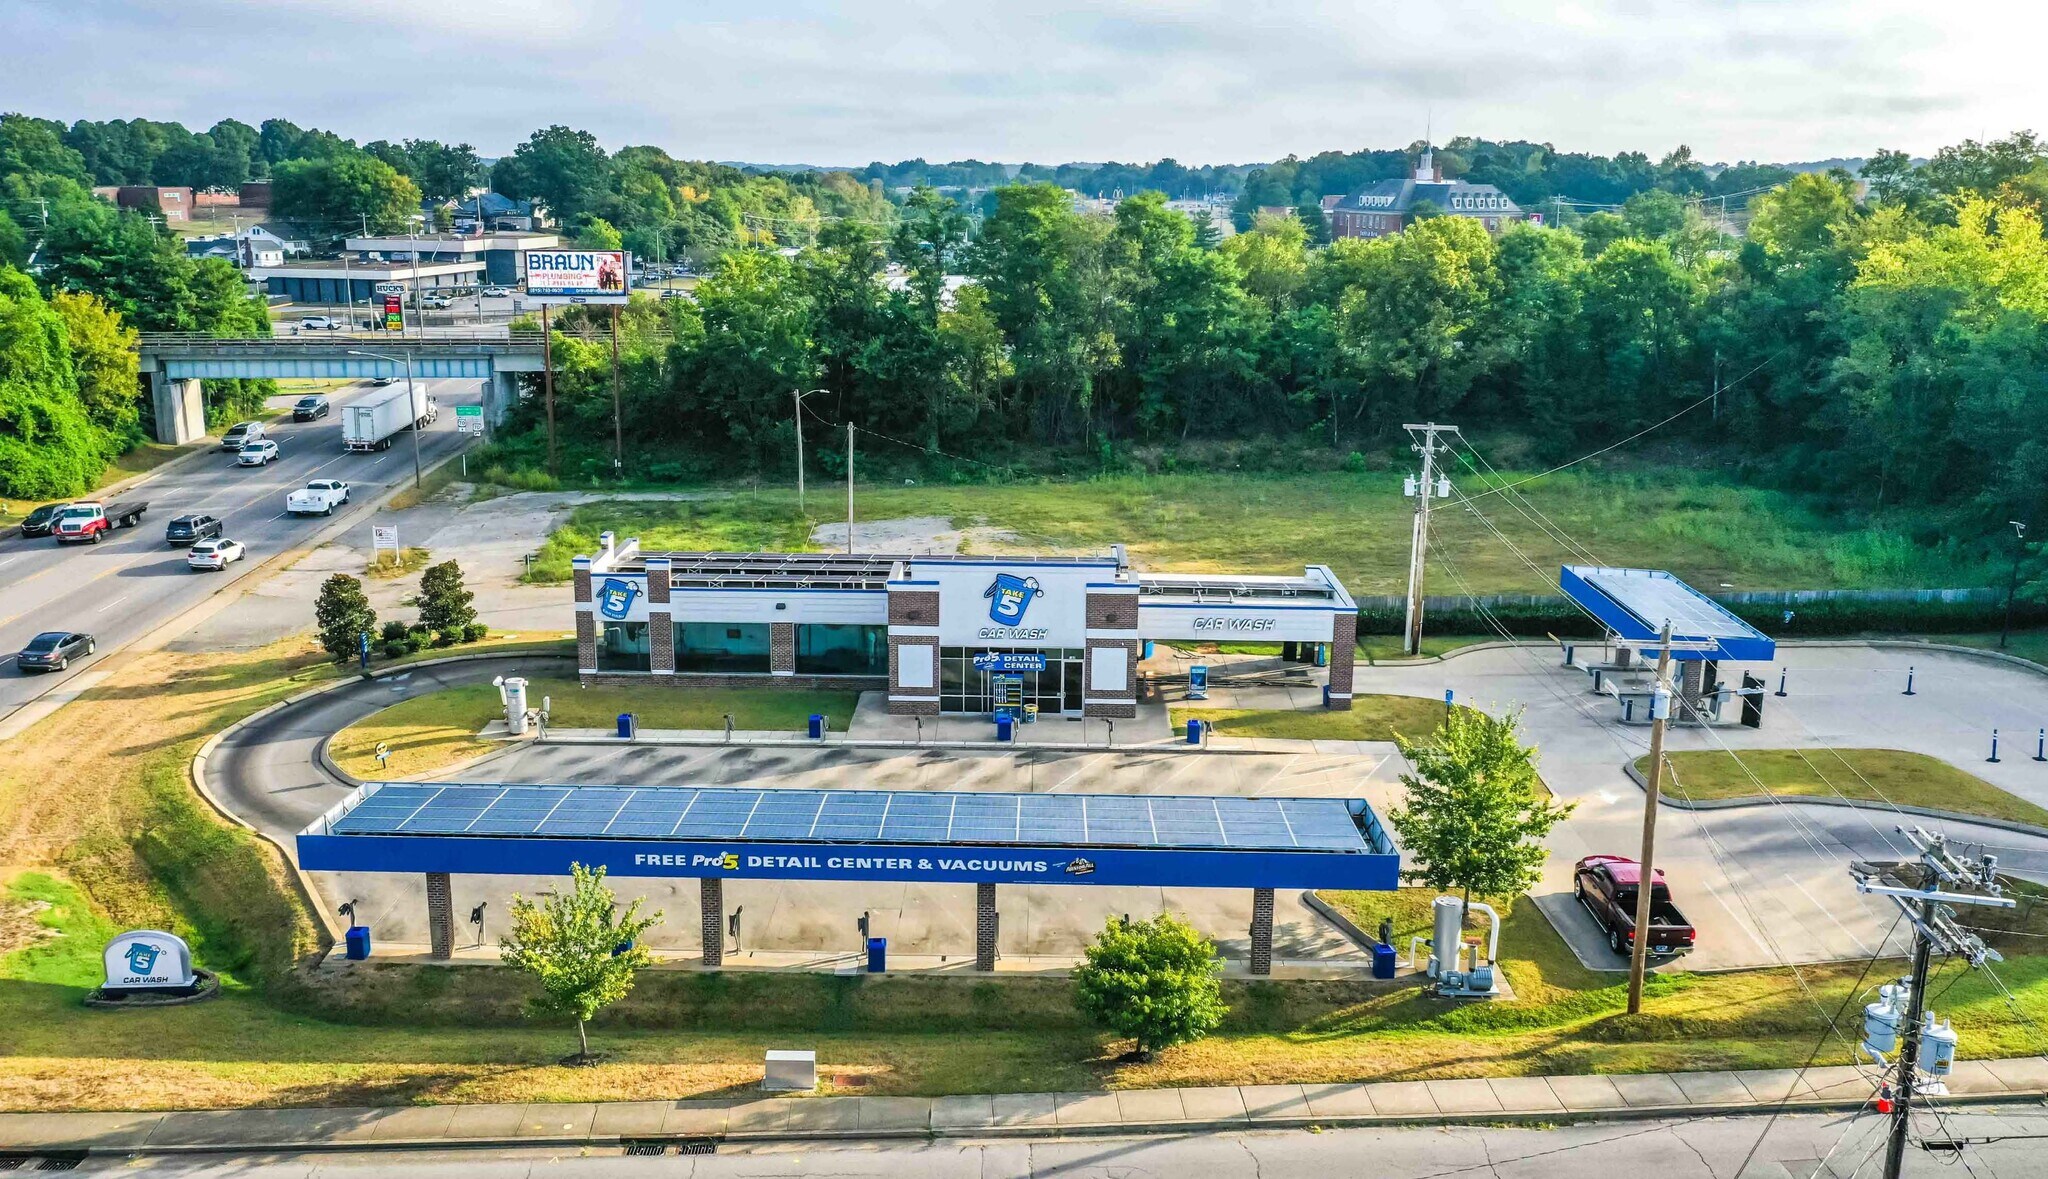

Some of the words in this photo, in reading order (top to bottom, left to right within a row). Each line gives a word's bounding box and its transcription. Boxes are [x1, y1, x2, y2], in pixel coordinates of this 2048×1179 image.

[528, 254, 595, 271] BRAUN
[609, 589, 628, 597] TAKE
[1001, 588, 1026, 599] TAKE
[607, 595, 626, 612] 5
[997, 594, 1022, 616] 5
[1193, 617, 1225, 630] CAR
[1228, 618, 1276, 631] WASH
[979, 627, 1006, 640] CAR
[1009, 628, 1049, 640] WASH
[634, 854, 687, 866] FREE
[747, 856, 822, 868] DETAIL
[827, 857, 913, 870] CENTER
[917, 858, 934, 870] &
[938, 859, 1048, 872] VACUUMS
[134, 956, 150, 969] 5
[123, 976, 141, 984] CAR
